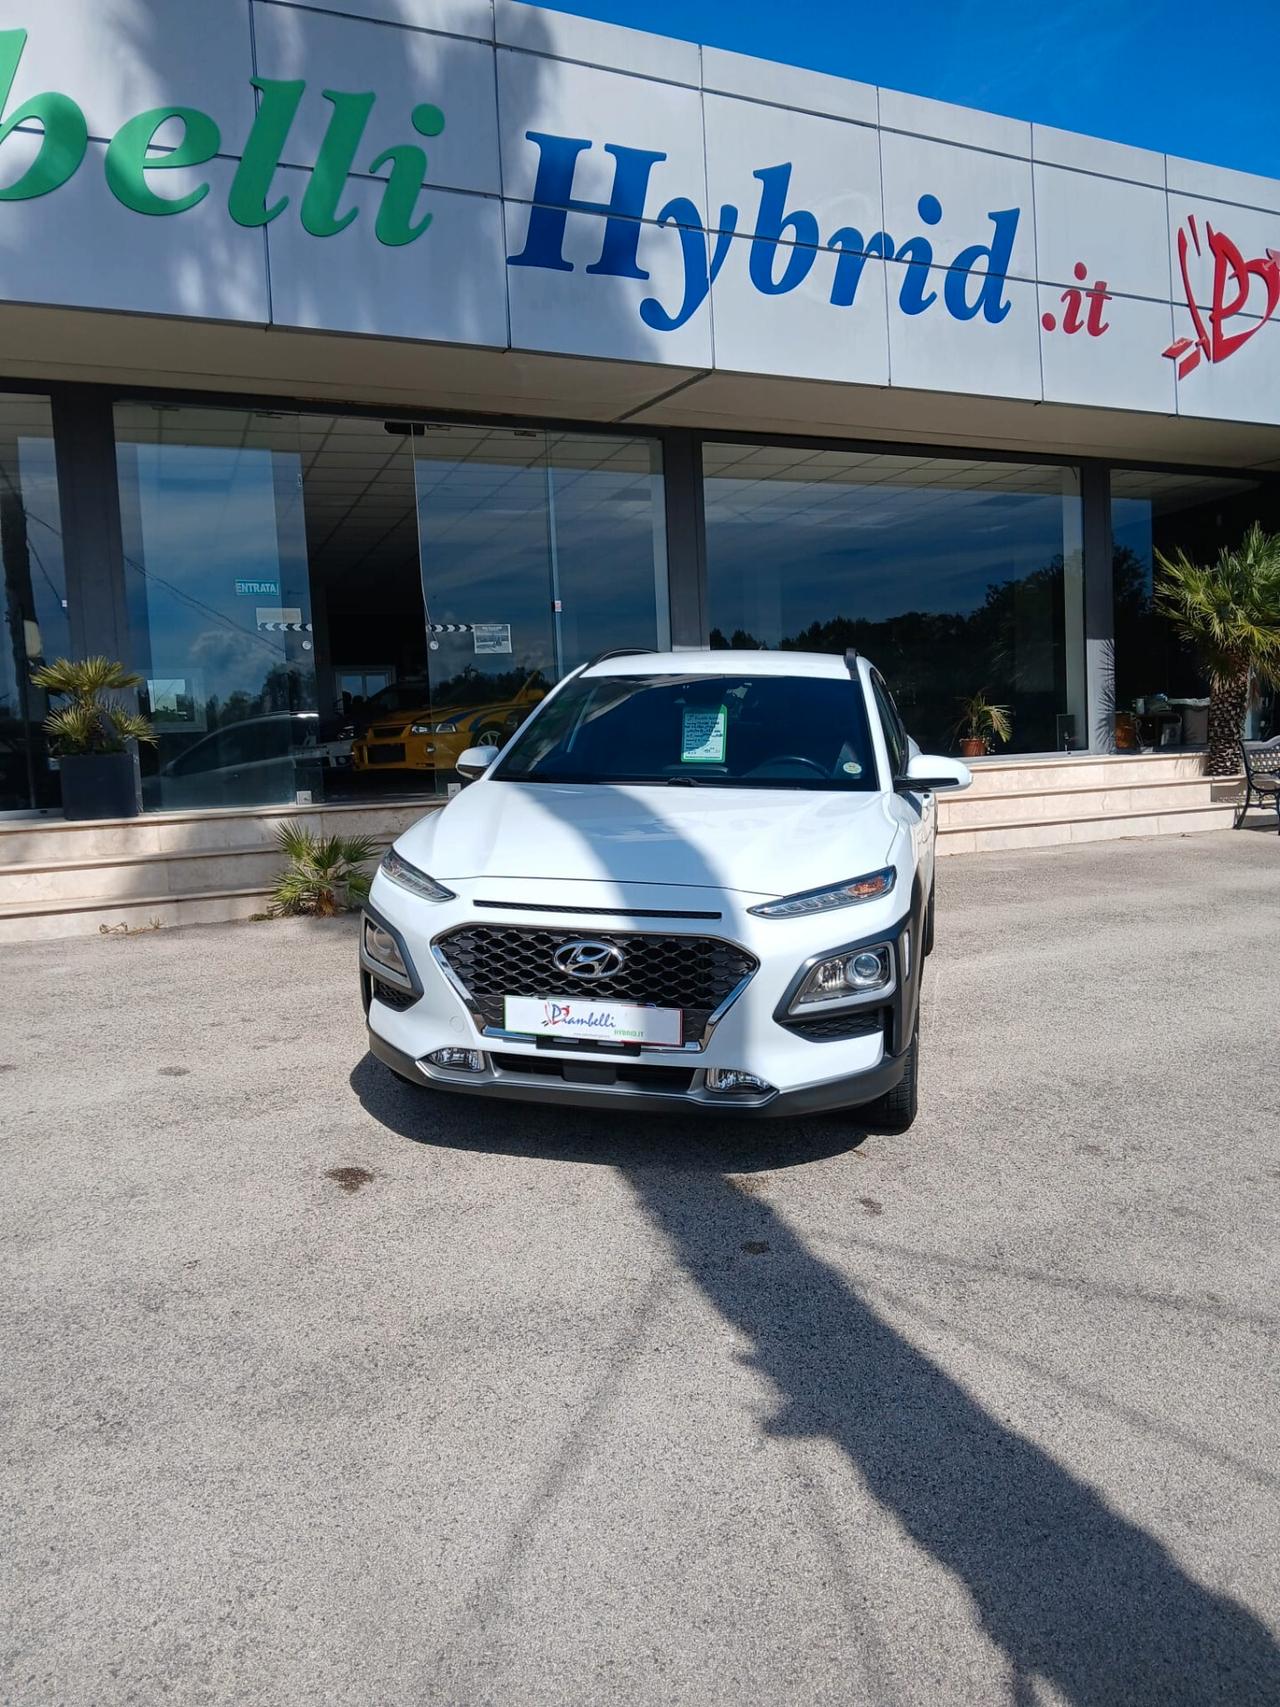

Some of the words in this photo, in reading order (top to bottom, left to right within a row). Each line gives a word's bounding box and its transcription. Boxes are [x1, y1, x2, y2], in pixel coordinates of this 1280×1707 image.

[506, 131, 1020, 331] Hybrid
[236, 583, 277, 593] ENTRATA
[551, 1003, 616, 1028] Diambelli
